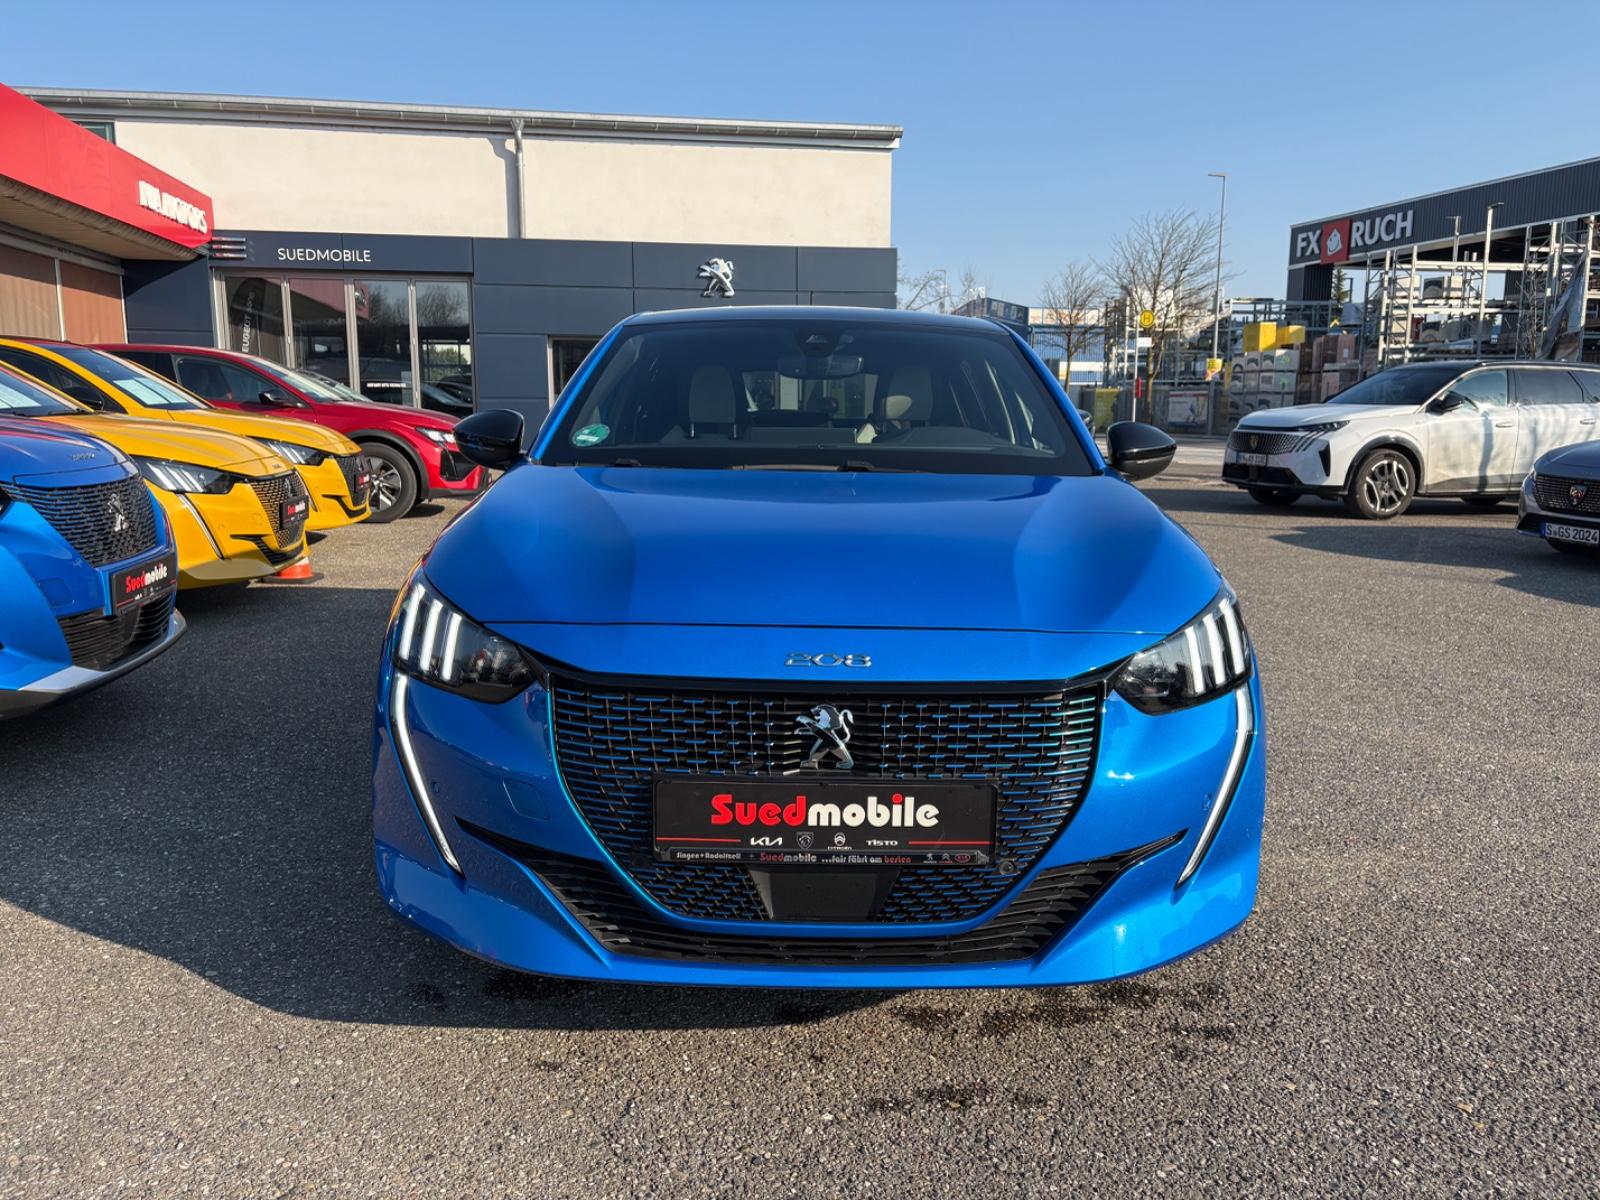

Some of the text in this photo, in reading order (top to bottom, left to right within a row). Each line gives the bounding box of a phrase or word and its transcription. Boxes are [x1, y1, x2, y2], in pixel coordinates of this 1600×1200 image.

[1296, 210, 1414, 257] FX RUCH
[277, 247, 372, 263] SUEDMOBILE
[241, 314, 252, 353] EUGEOT
[1546, 525, 1598, 542] S GS 2024
[785, 653, 871, 668] 208
[711, 793, 940, 827] Suedmobile
[759, 852, 817, 863] Suedmobile
